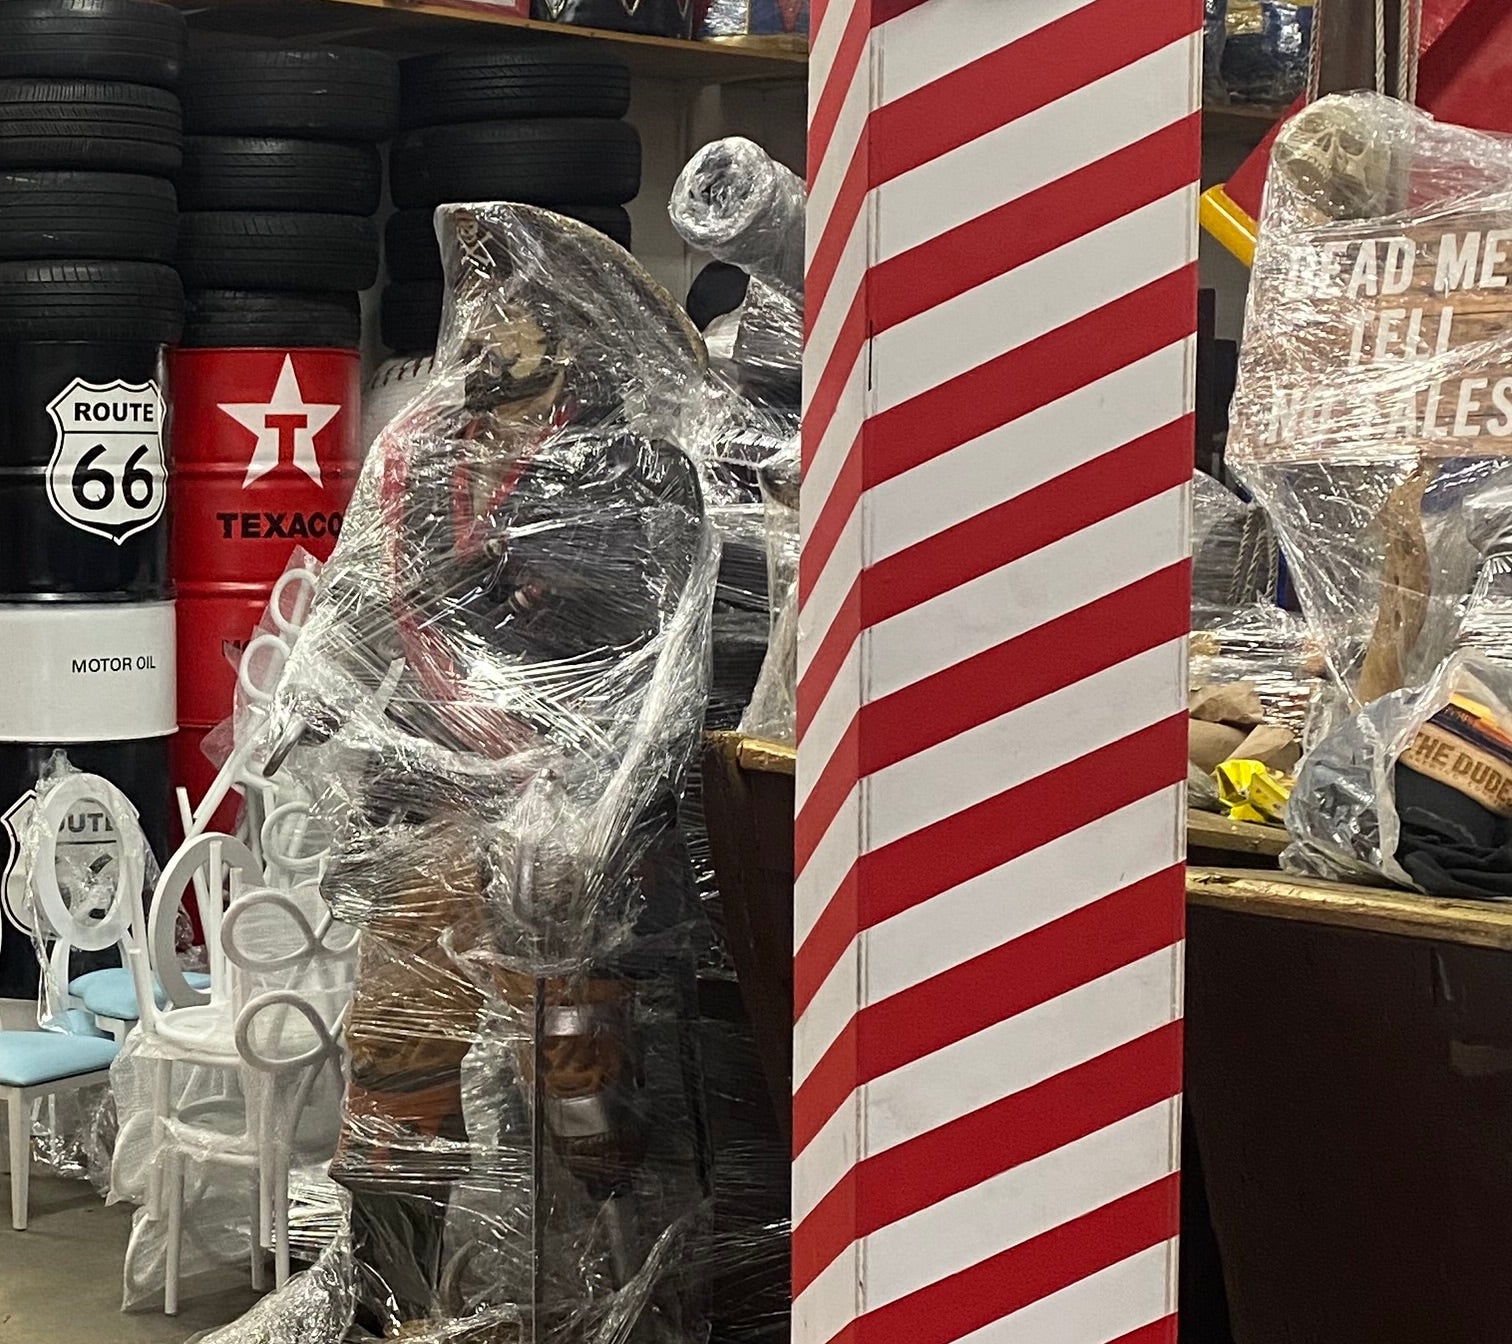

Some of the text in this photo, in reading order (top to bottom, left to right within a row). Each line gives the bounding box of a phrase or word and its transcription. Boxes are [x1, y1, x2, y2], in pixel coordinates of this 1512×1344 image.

[74, 402, 155, 423] ROUTE
[71, 443, 155, 511] 66
[216, 511, 344, 539] TEXACO
[71, 655, 156, 673] MOTOR OIL
